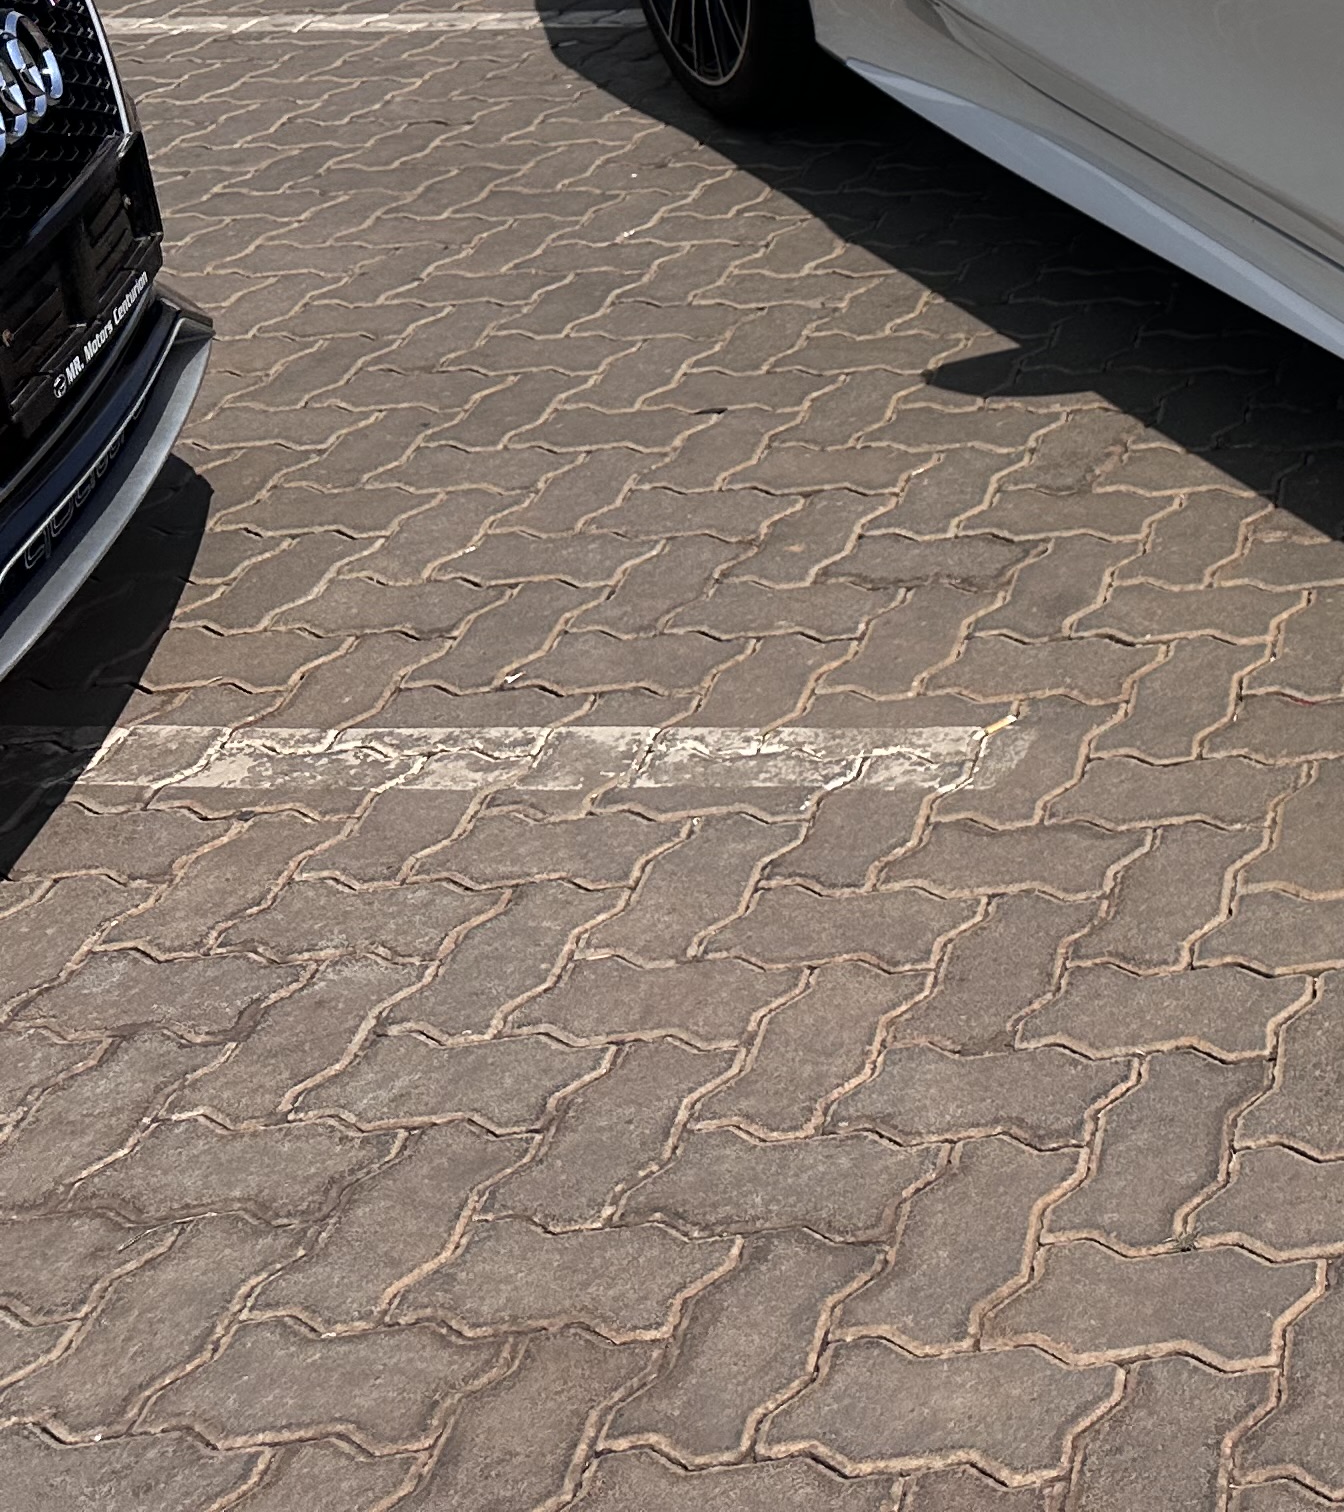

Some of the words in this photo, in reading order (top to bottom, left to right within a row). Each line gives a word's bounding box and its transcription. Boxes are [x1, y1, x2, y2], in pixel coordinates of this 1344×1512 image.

[65, 355, 85, 385] MR.
[83, 319, 114, 363] Motors
[112, 271, 148, 326] Centurion
